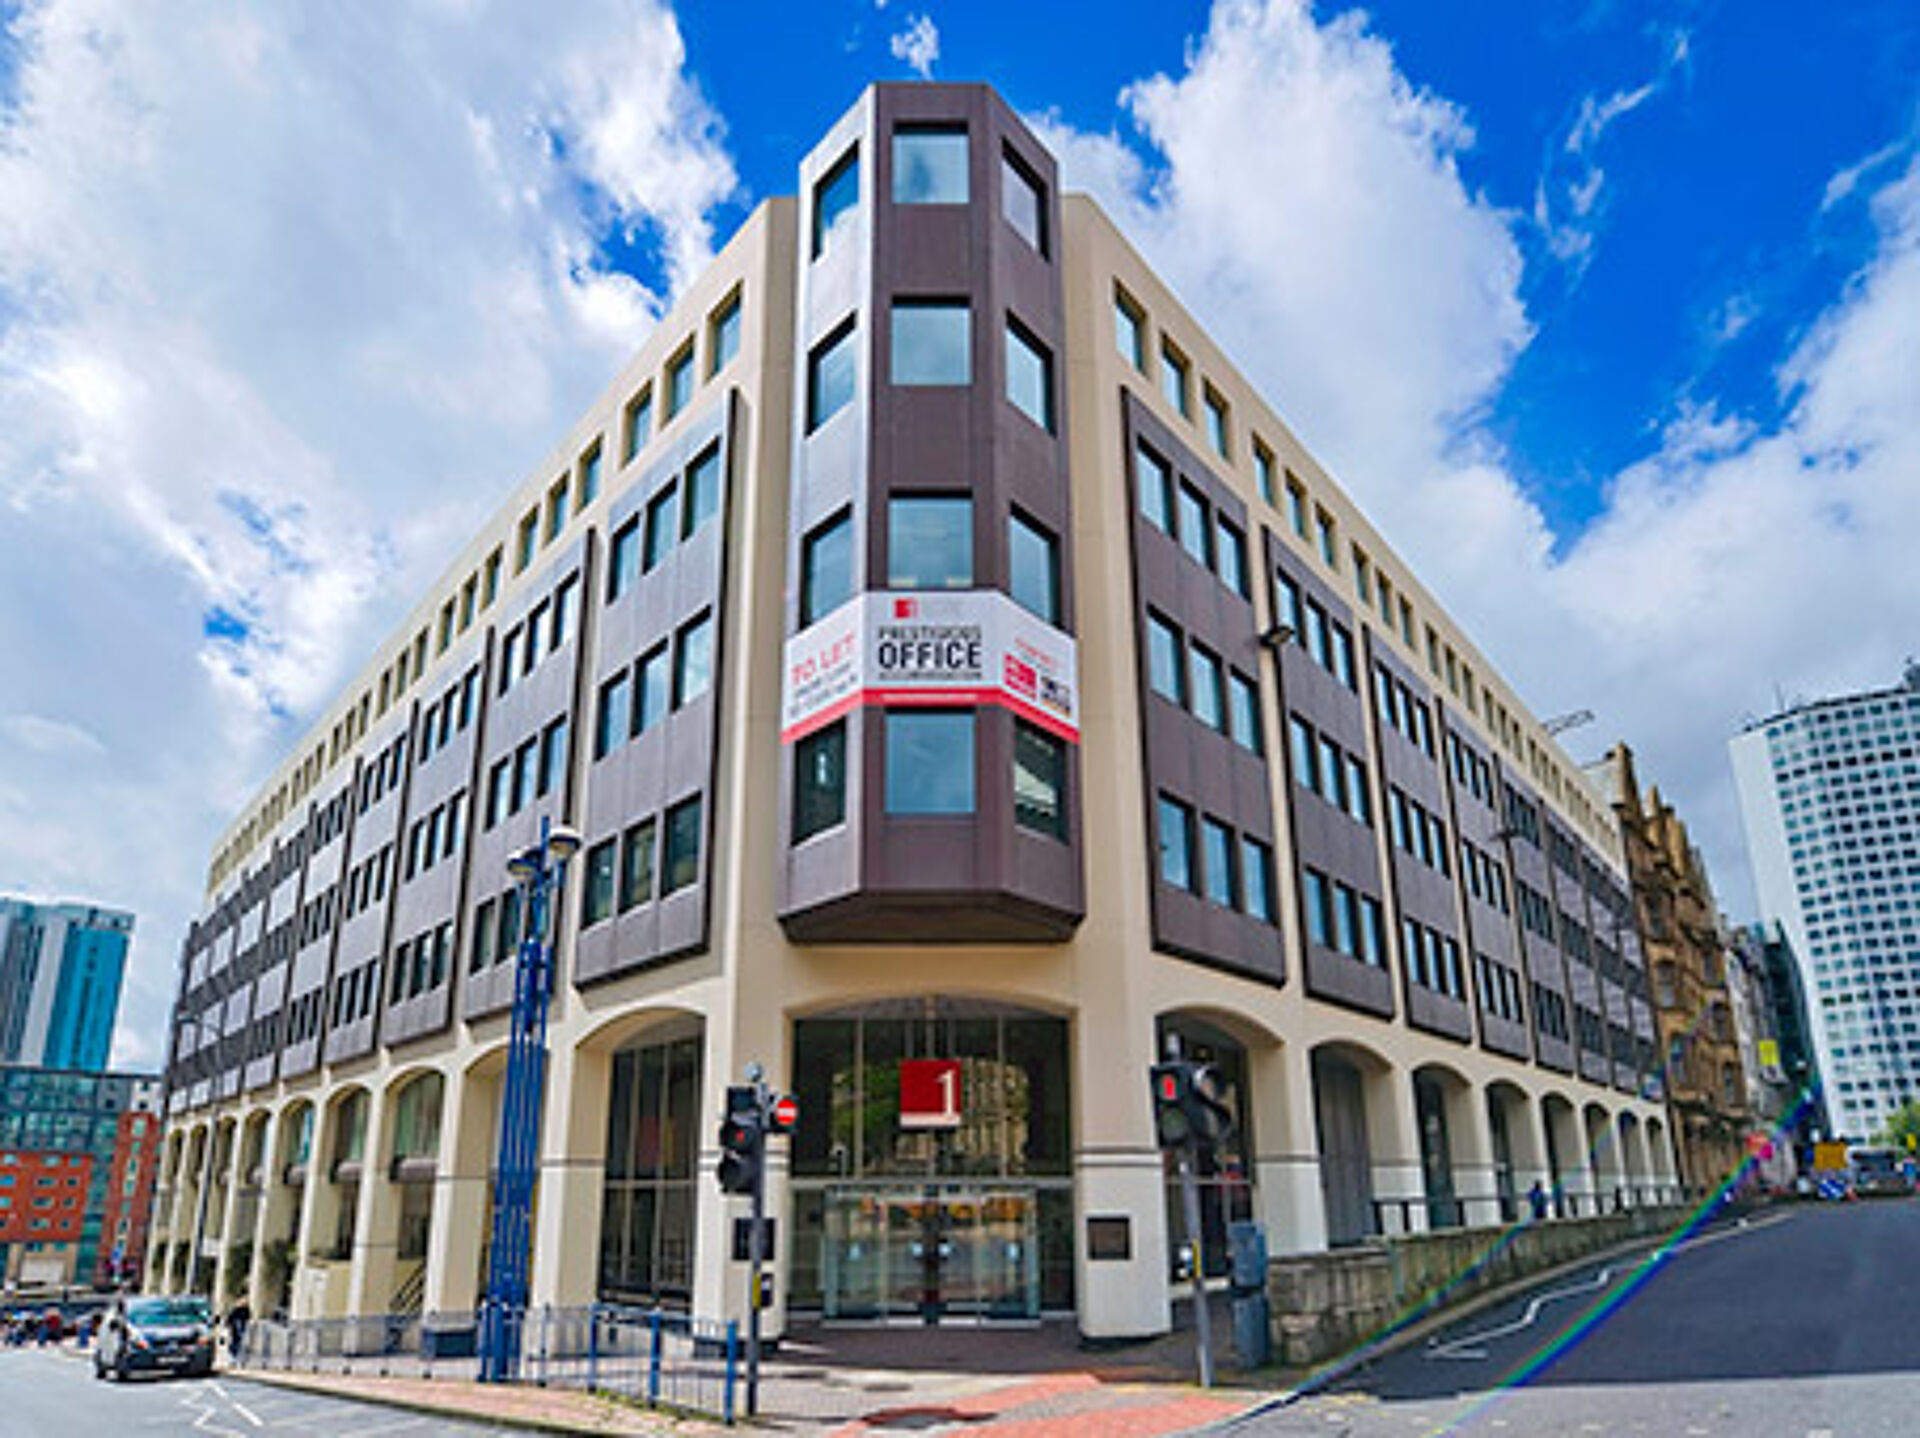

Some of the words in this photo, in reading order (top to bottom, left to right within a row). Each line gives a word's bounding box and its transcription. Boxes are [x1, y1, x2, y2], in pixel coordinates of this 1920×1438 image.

[792, 654, 818, 688] TO
[820, 631, 855, 669] LET
[879, 641, 982, 669] OFFICE
[935, 1069, 956, 1117] 1
